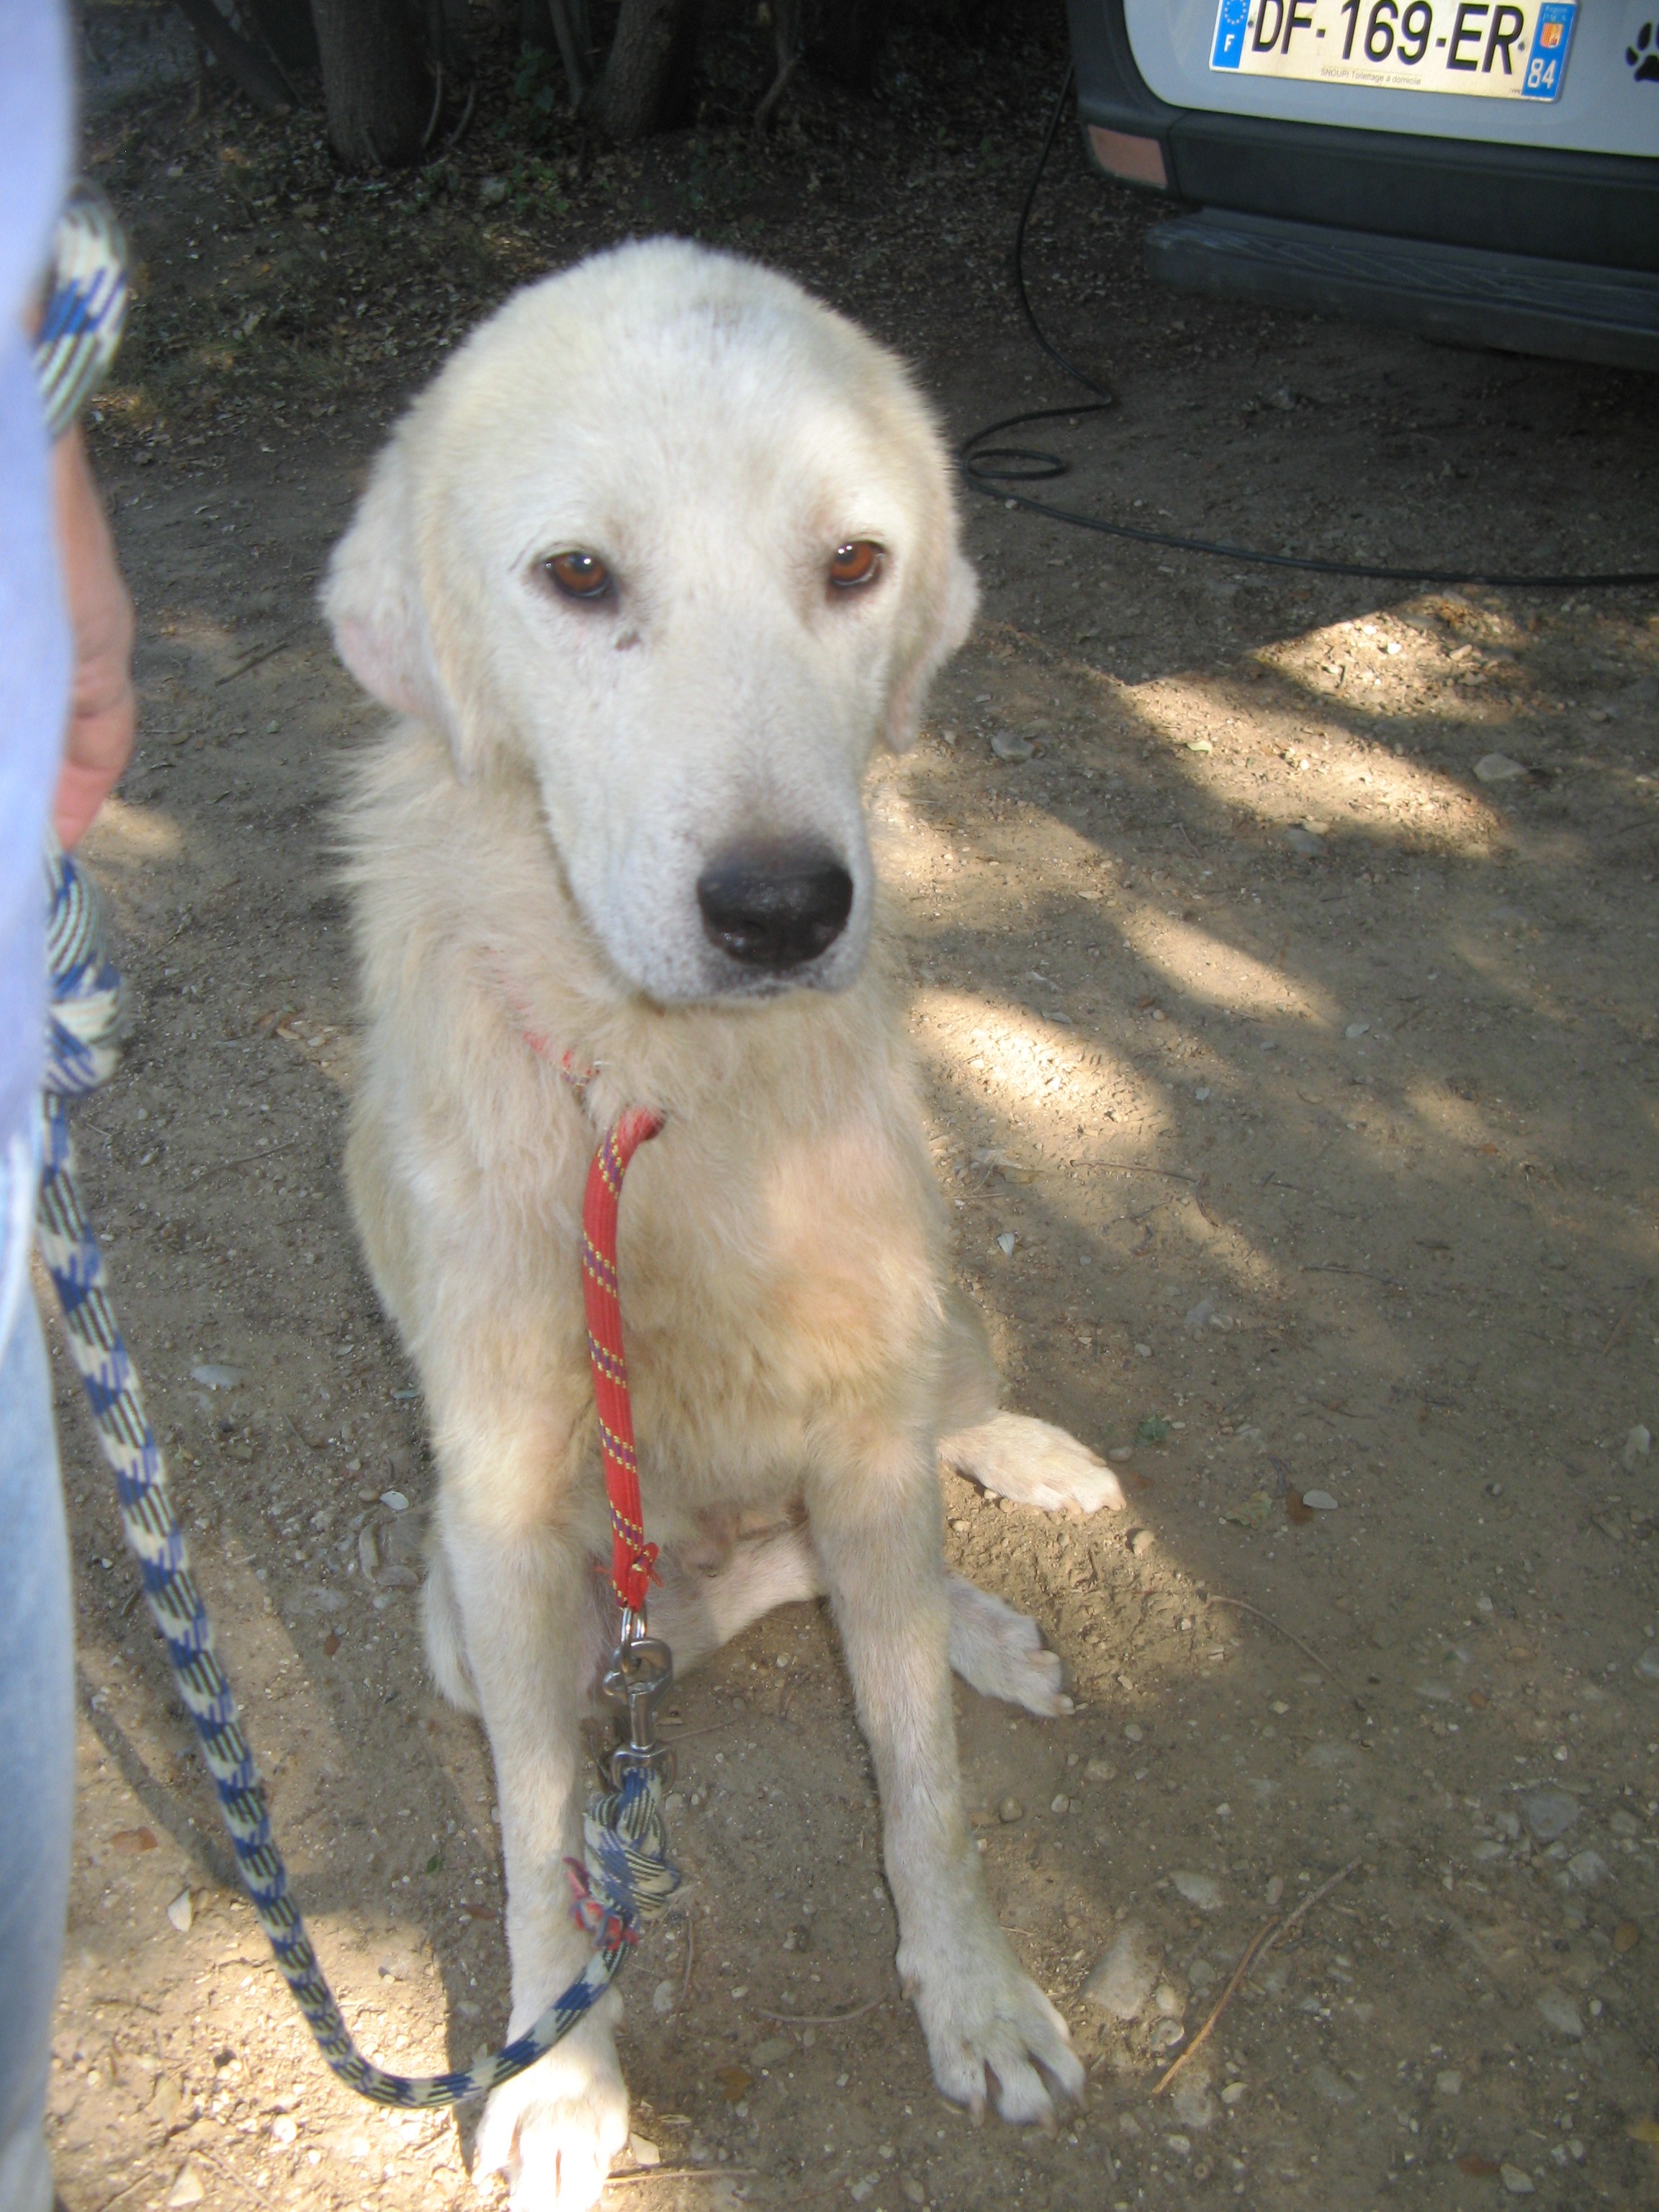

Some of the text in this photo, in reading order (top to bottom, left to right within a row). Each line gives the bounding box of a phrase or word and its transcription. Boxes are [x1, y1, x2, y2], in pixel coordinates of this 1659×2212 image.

[1223, 34, 1235, 53] F
[1351, 71, 1384, 83] Toilettage
[1392, 75, 1421, 85] domicile
[1527, 58, 1556, 89] 84
